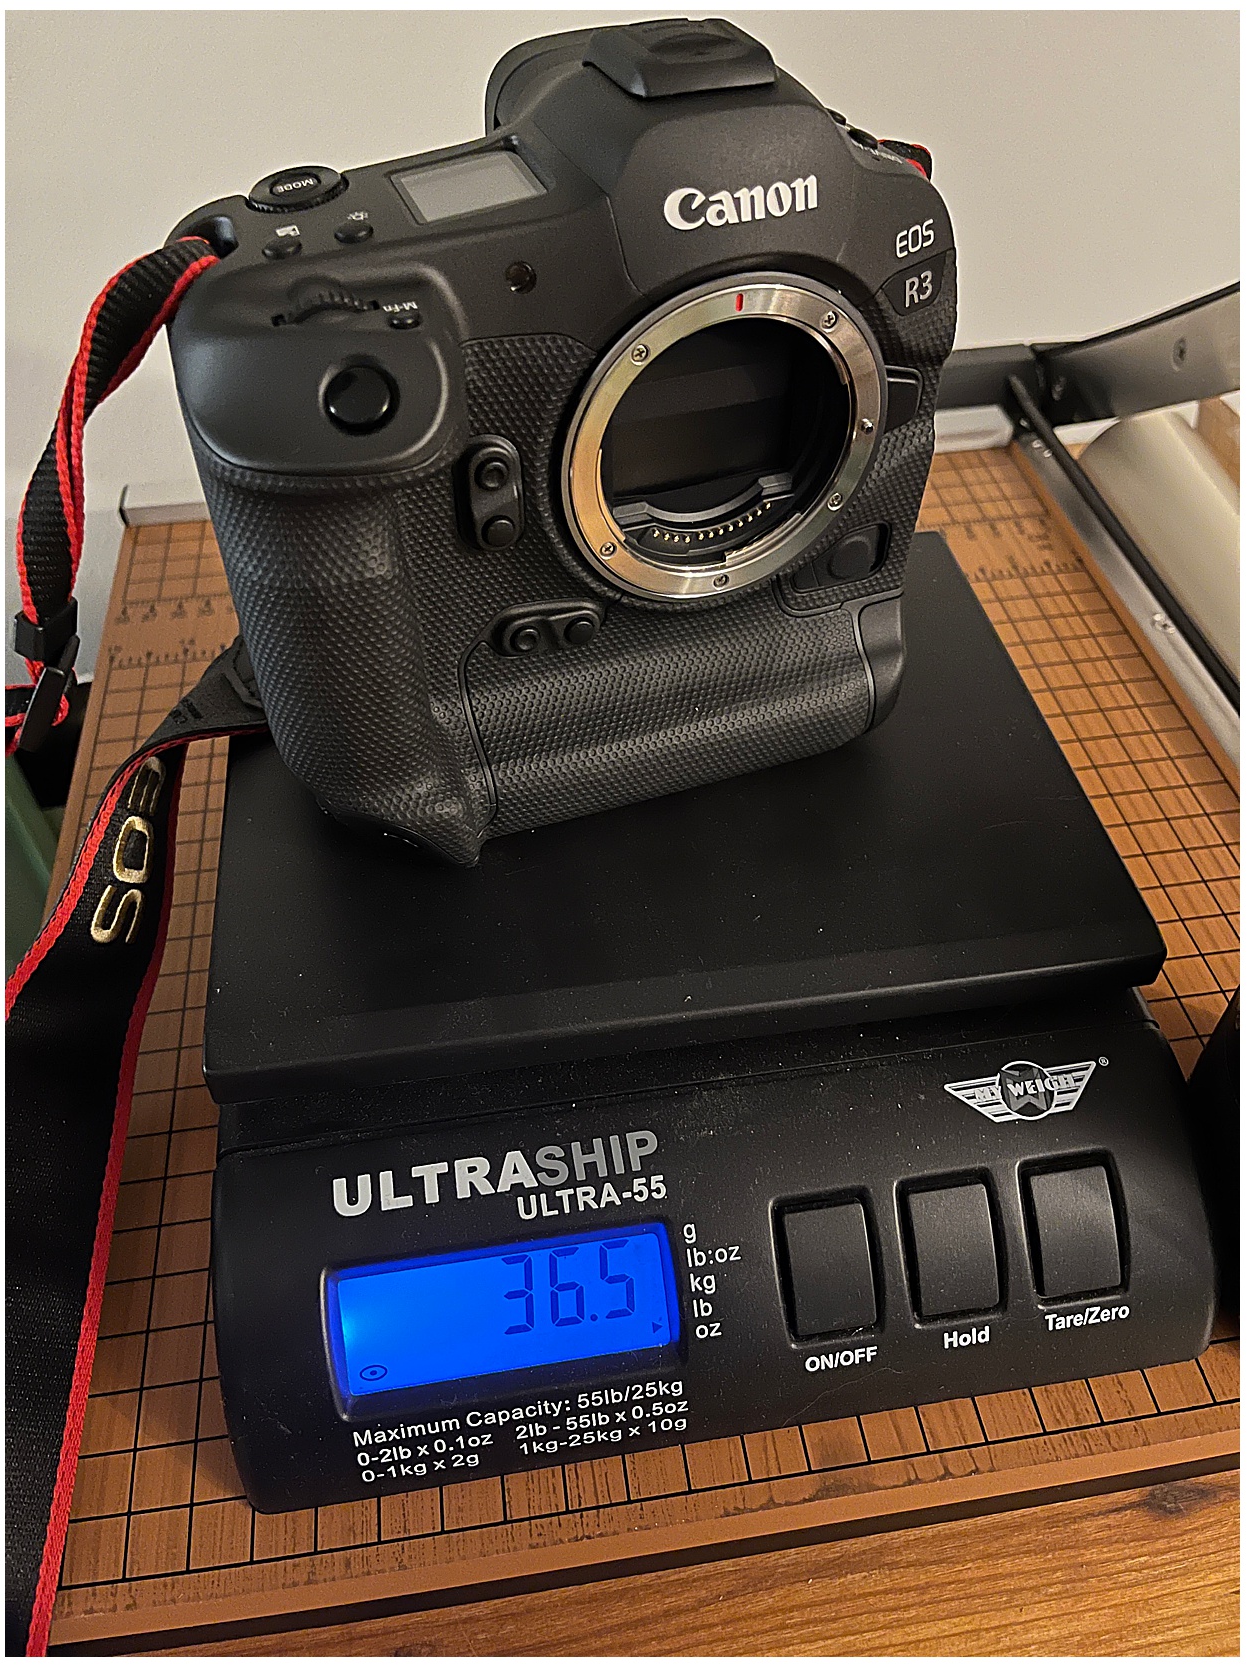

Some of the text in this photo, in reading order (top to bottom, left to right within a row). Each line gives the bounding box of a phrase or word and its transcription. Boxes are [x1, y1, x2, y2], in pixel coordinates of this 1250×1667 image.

[276, 178, 315, 193] MODE
[663, 174, 818, 231] Canon
[894, 218, 936, 258] EOS
[904, 270, 934, 308] R3
[382, 300, 419, 313] M-Fn
[90, 756, 166, 943] EOS
[1006, 1073, 1076, 1098] WEIGH
[332, 1130, 659, 1217] ULTRASHIP
[516, 1175, 667, 1220] ULTRA-55
[682, 1223, 697, 1244] g
[686, 1245, 742, 1268] lb:oz
[501, 1238, 636, 1335] 36.5
[689, 1273, 716, 1294] kg
[692, 1299, 713, 1318] lb
[1044, 1303, 1130, 1333] Tare/Zero
[695, 1321, 723, 1339] oz
[943, 1326, 990, 1350] Hold
[805, 1345, 878, 1373] ON/OFF
[353, 1380, 683, 1448] Maximum Capacity: 55lb/25kg
[357, 1446, 412, 1467] 0-2lb
[416, 1444, 430, 1457] x
[433, 1433, 494, 1453] 0.1oz
[515, 1423, 547, 1440] 2lb
[566, 1412, 610, 1431] 55lb
[615, 1410, 627, 1423] x
[631, 1400, 689, 1420] 0.5oz
[361, 1418, 688, 1483] 0-1kg x 2g 1kg-25kg x 10g
